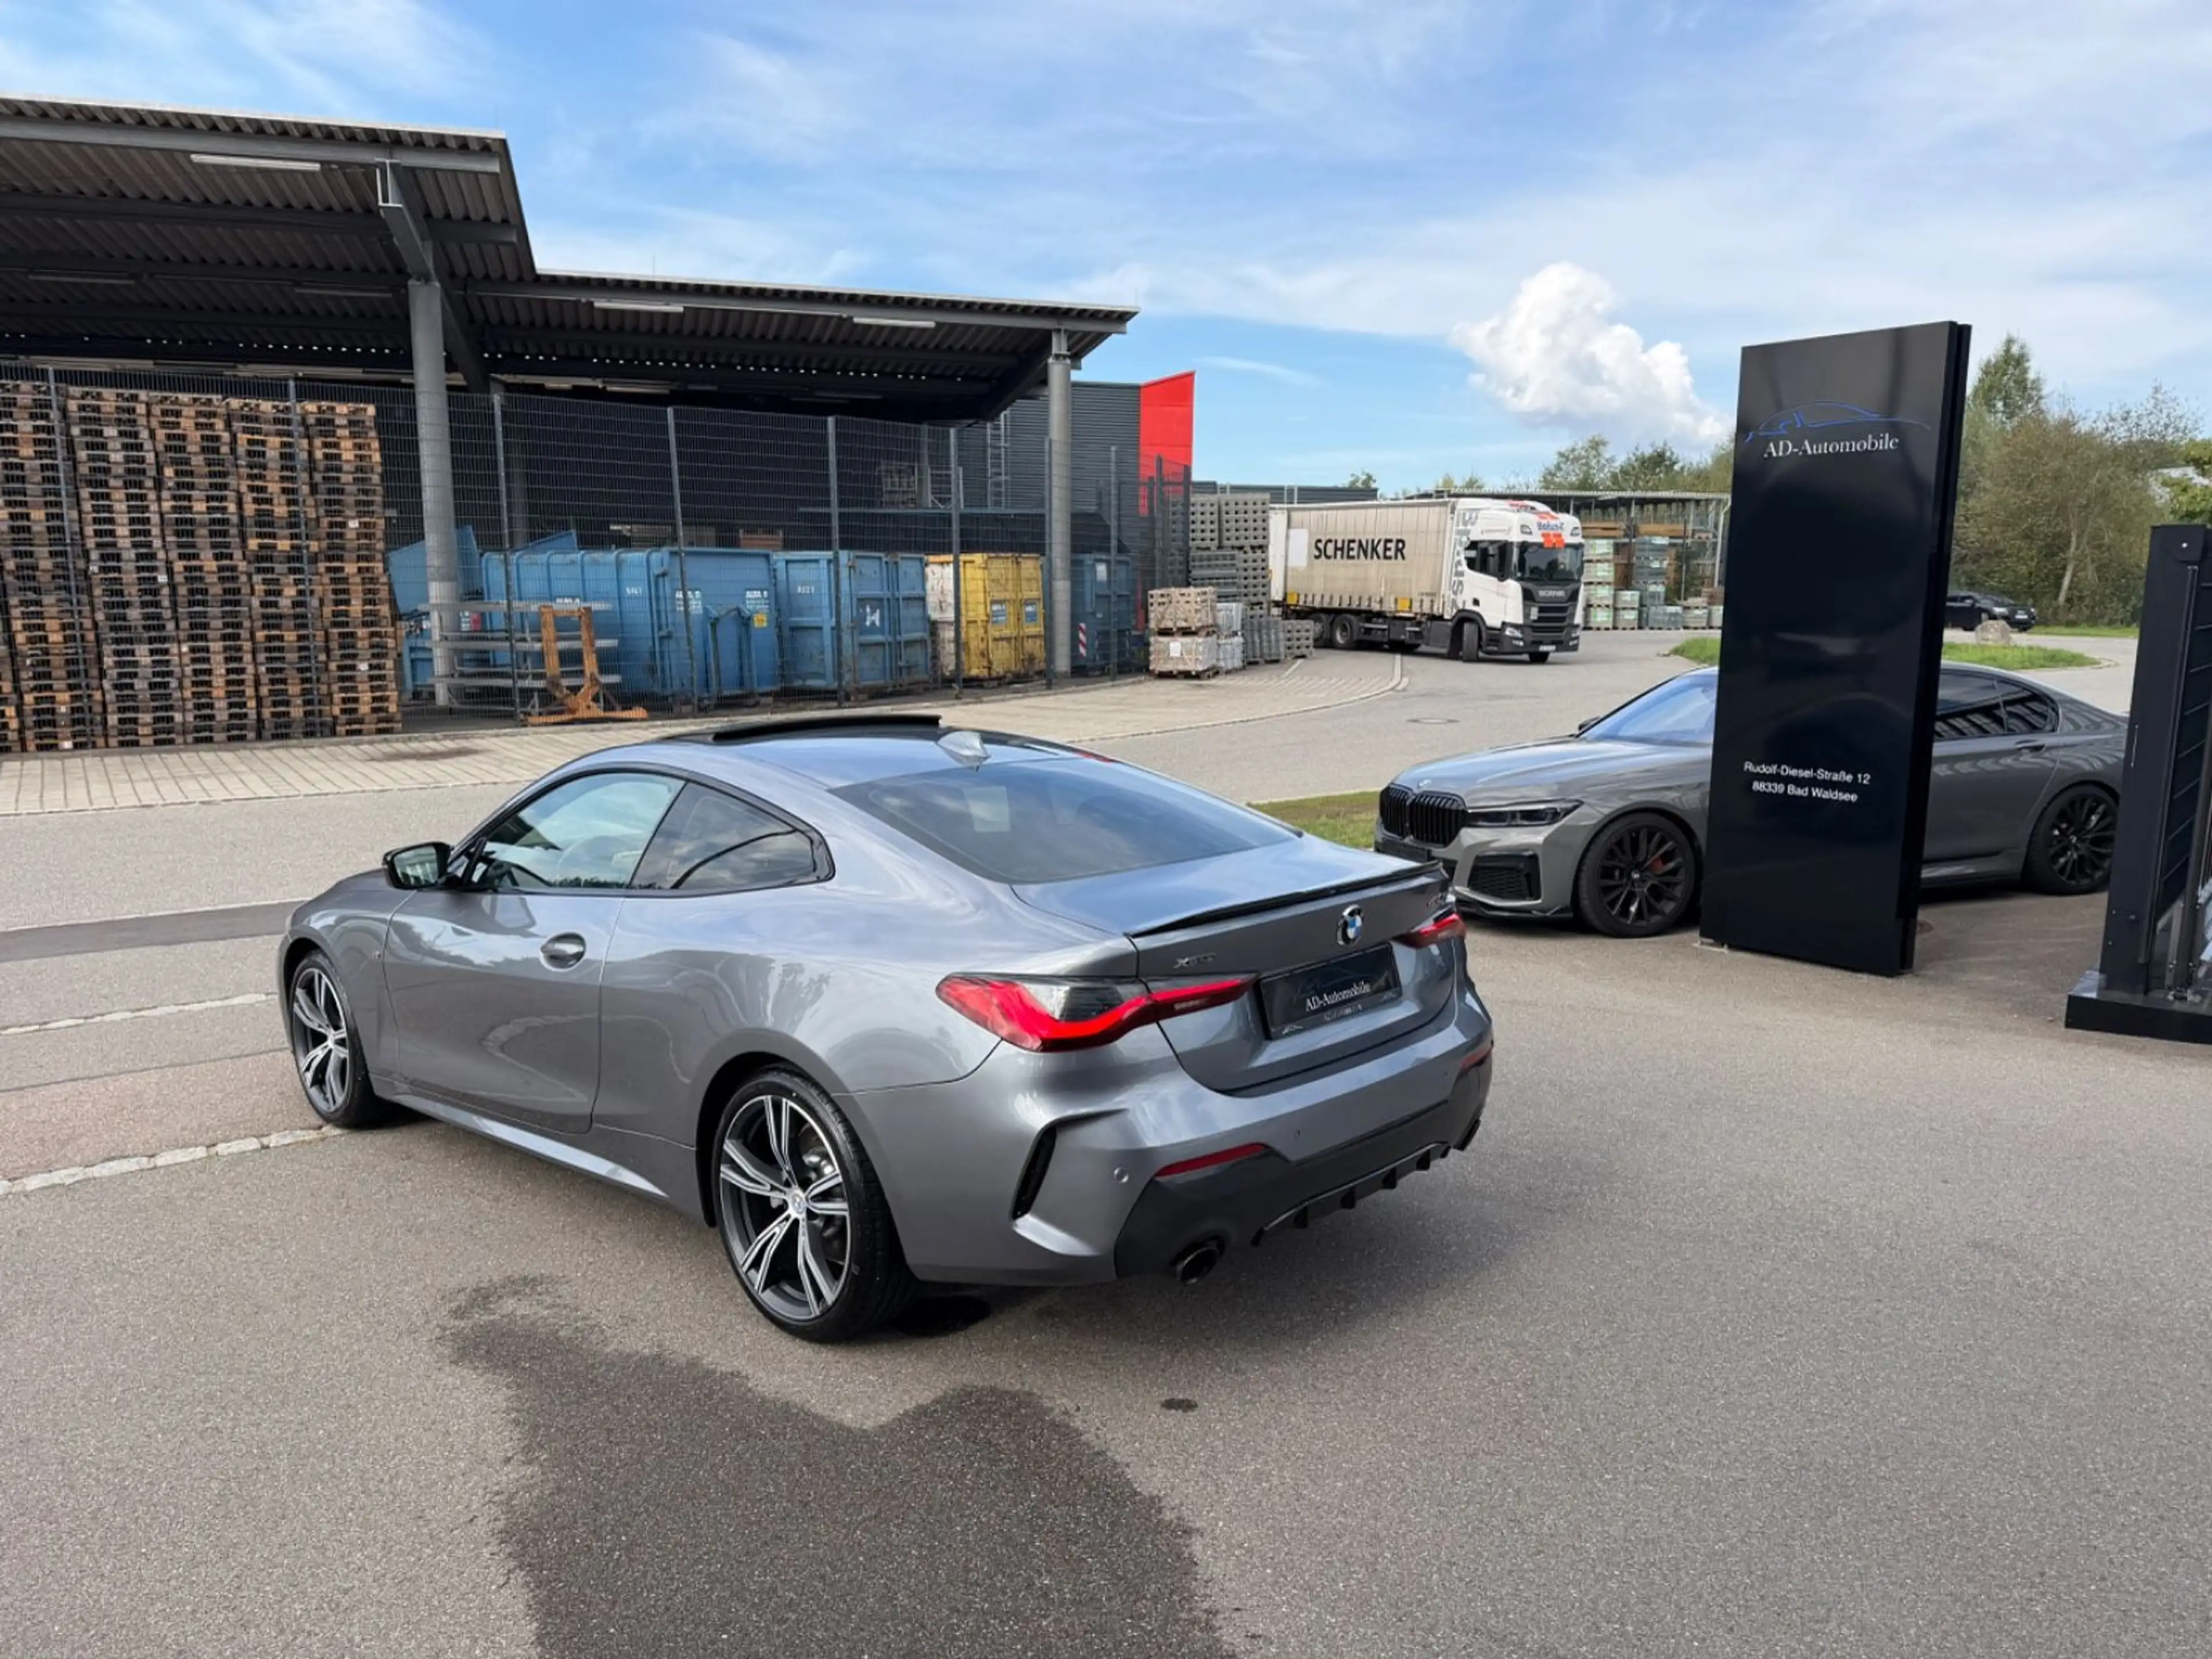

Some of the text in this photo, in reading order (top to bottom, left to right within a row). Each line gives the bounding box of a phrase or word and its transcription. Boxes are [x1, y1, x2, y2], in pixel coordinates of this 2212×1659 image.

[1764, 433, 1899, 457] AD-Automobile
[1313, 539, 1406, 560] SCHENKER
[1744, 762, 1870, 784] Rudolf-Diesel-Straße 12
[1752, 781, 1858, 802] 88339 Bad Waldsee
